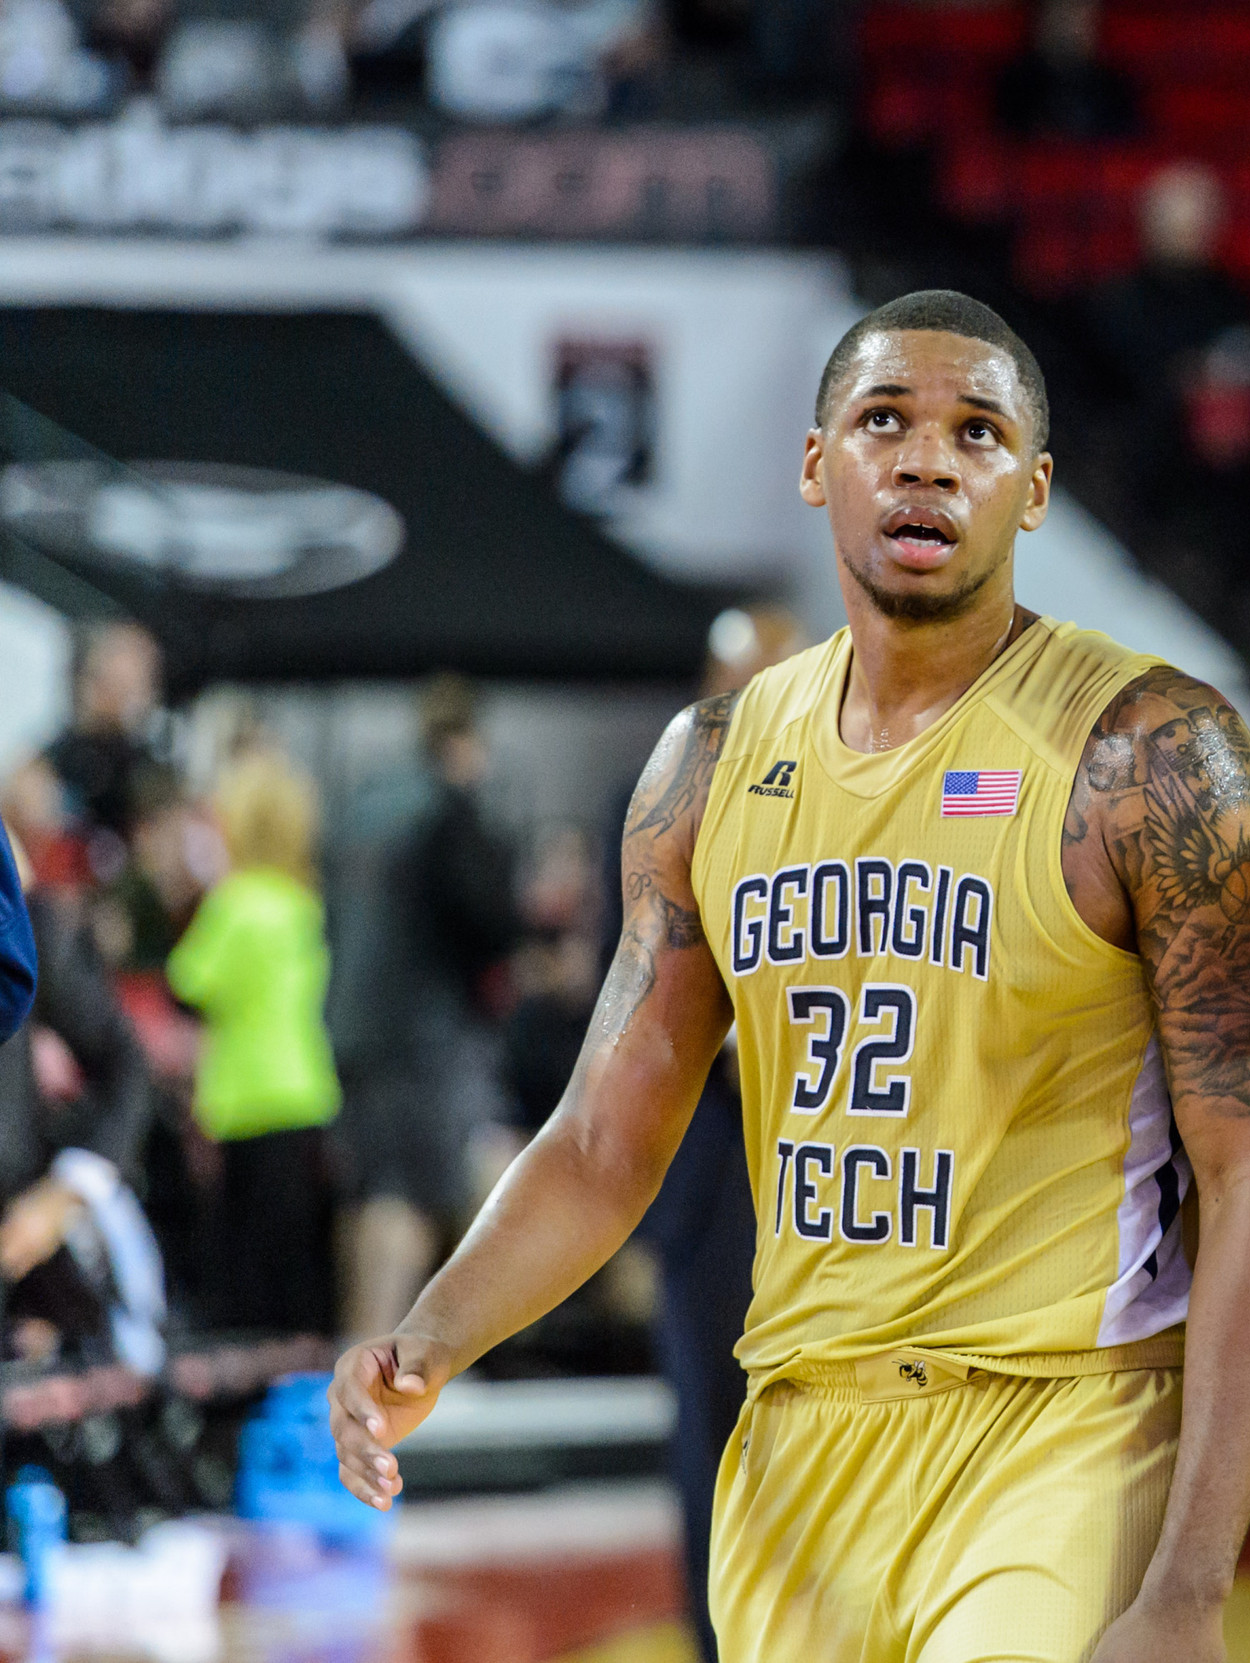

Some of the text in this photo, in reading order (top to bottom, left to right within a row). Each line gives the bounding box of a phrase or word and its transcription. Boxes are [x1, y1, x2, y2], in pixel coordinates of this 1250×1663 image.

[748, 784, 795, 799] RUSSELL
[732, 856, 994, 982] GEORGIA
[785, 982, 918, 1118] 32
[774, 1137, 955, 1251] TECH
